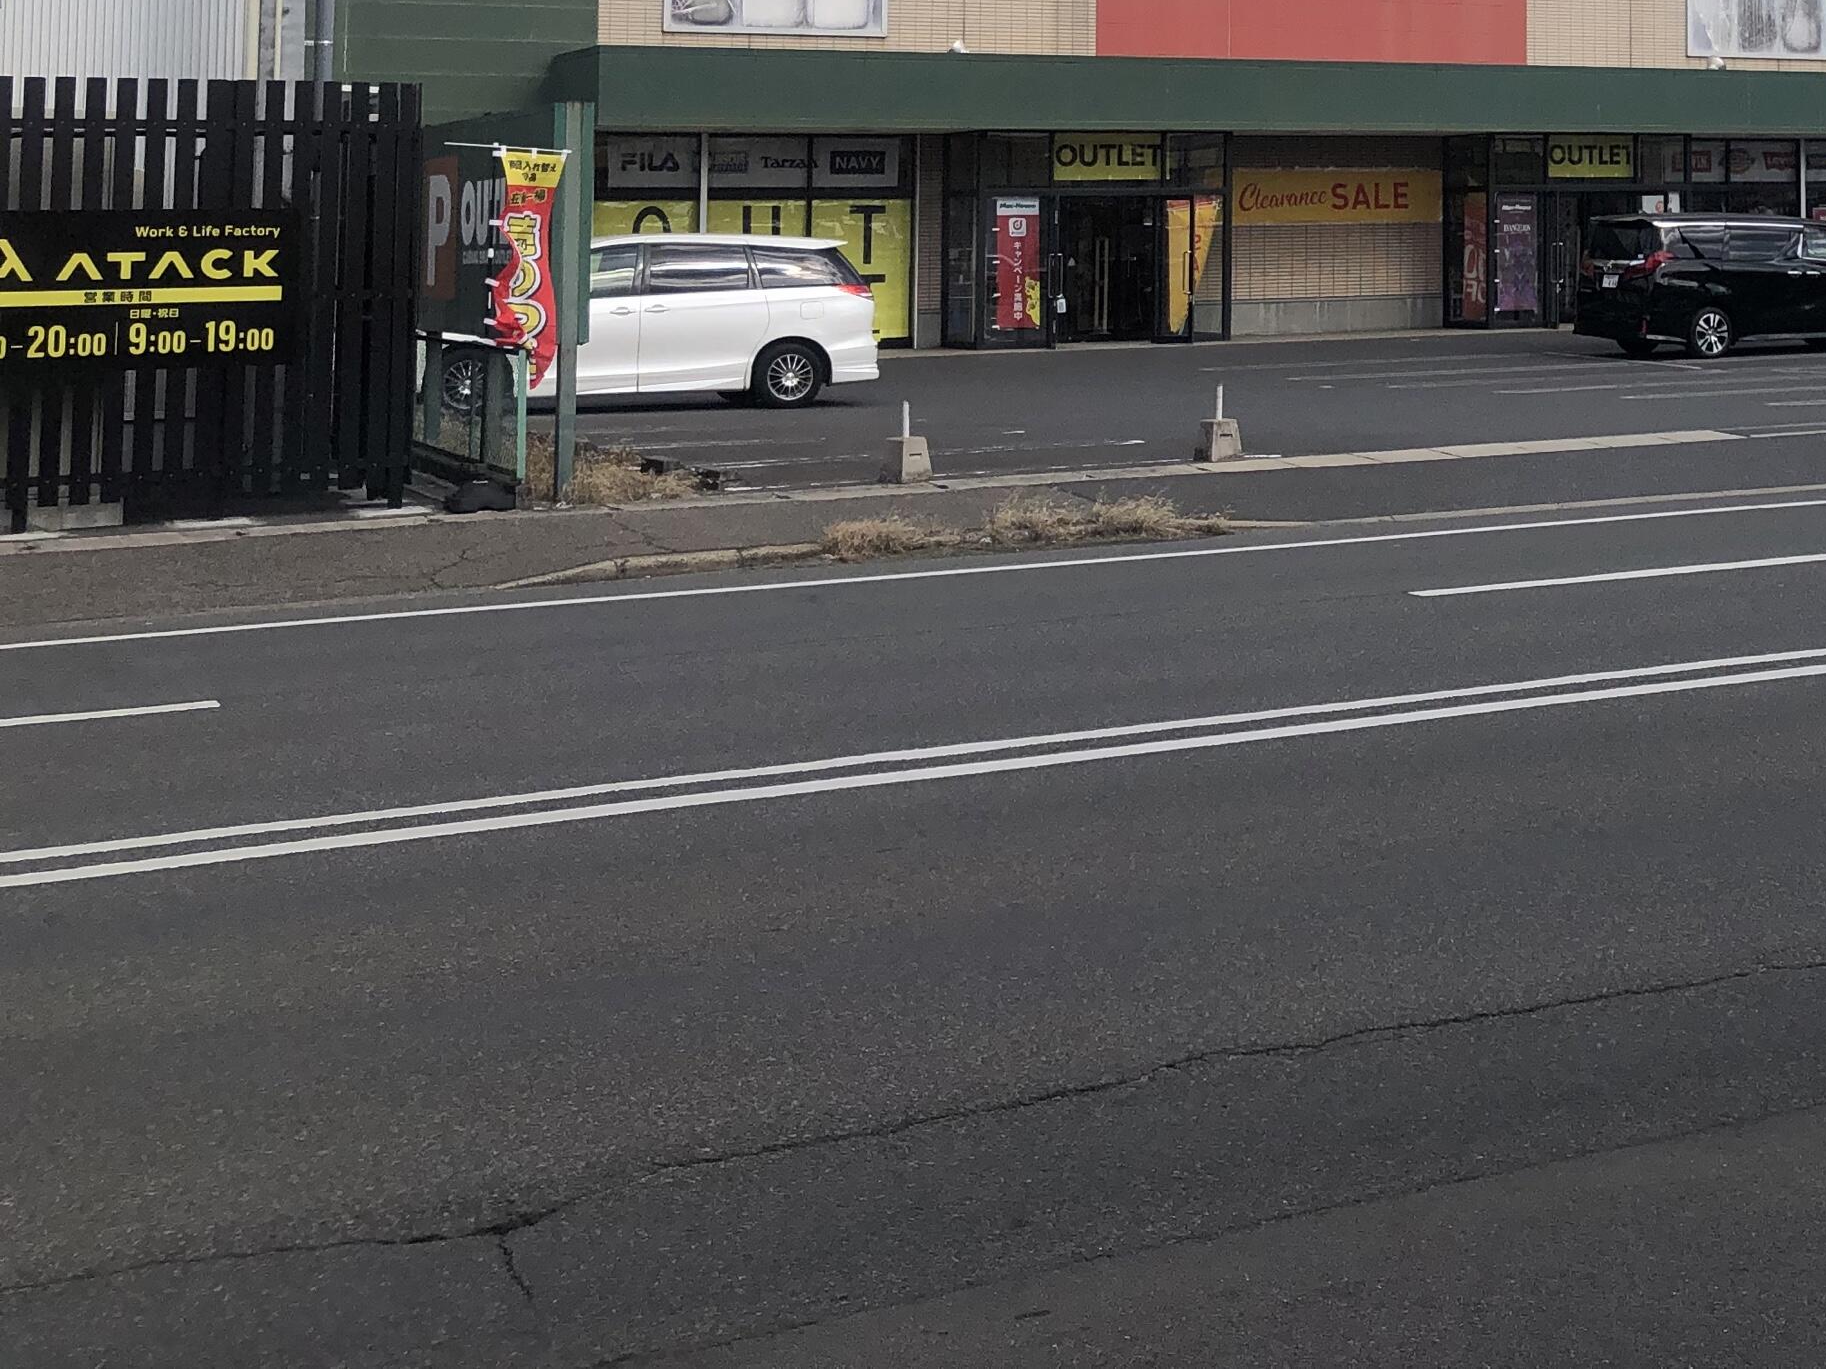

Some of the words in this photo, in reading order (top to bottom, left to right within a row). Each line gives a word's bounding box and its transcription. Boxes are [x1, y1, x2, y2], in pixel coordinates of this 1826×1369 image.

[620, 152, 680, 172] FILA
[834, 156, 880, 170] NAVY
[1055, 143, 1162, 167] OUTLET
[1238, 182, 1328, 212] Clearance
[1330, 182, 1409, 211] SALE
[135, 225, 174, 238] Work
[178, 226, 188, 237] &
[193, 225, 220, 238] Life
[224, 225, 281, 239] Factory
[83, 290, 153, 304] 営業時間
